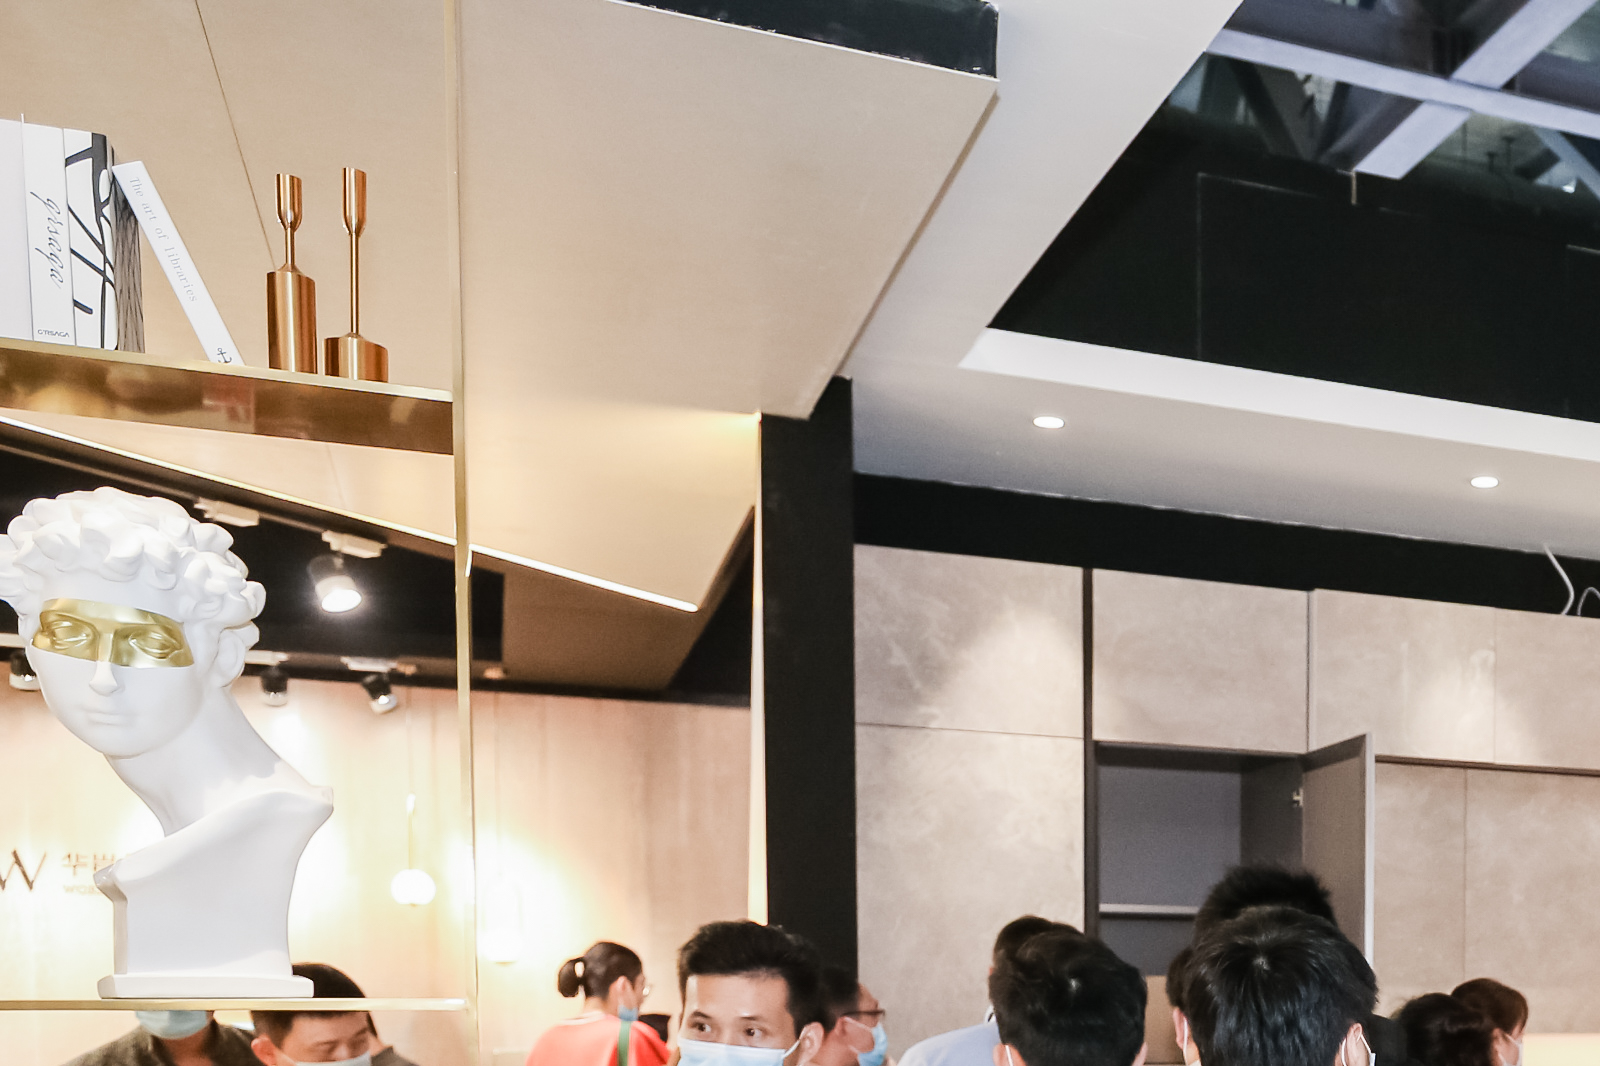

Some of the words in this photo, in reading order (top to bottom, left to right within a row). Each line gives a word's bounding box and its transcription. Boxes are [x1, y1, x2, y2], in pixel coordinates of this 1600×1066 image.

[129, 176, 145, 197] The
[141, 202, 157, 221] art
[154, 227, 170, 240] of
[164, 246, 198, 303] libraries
